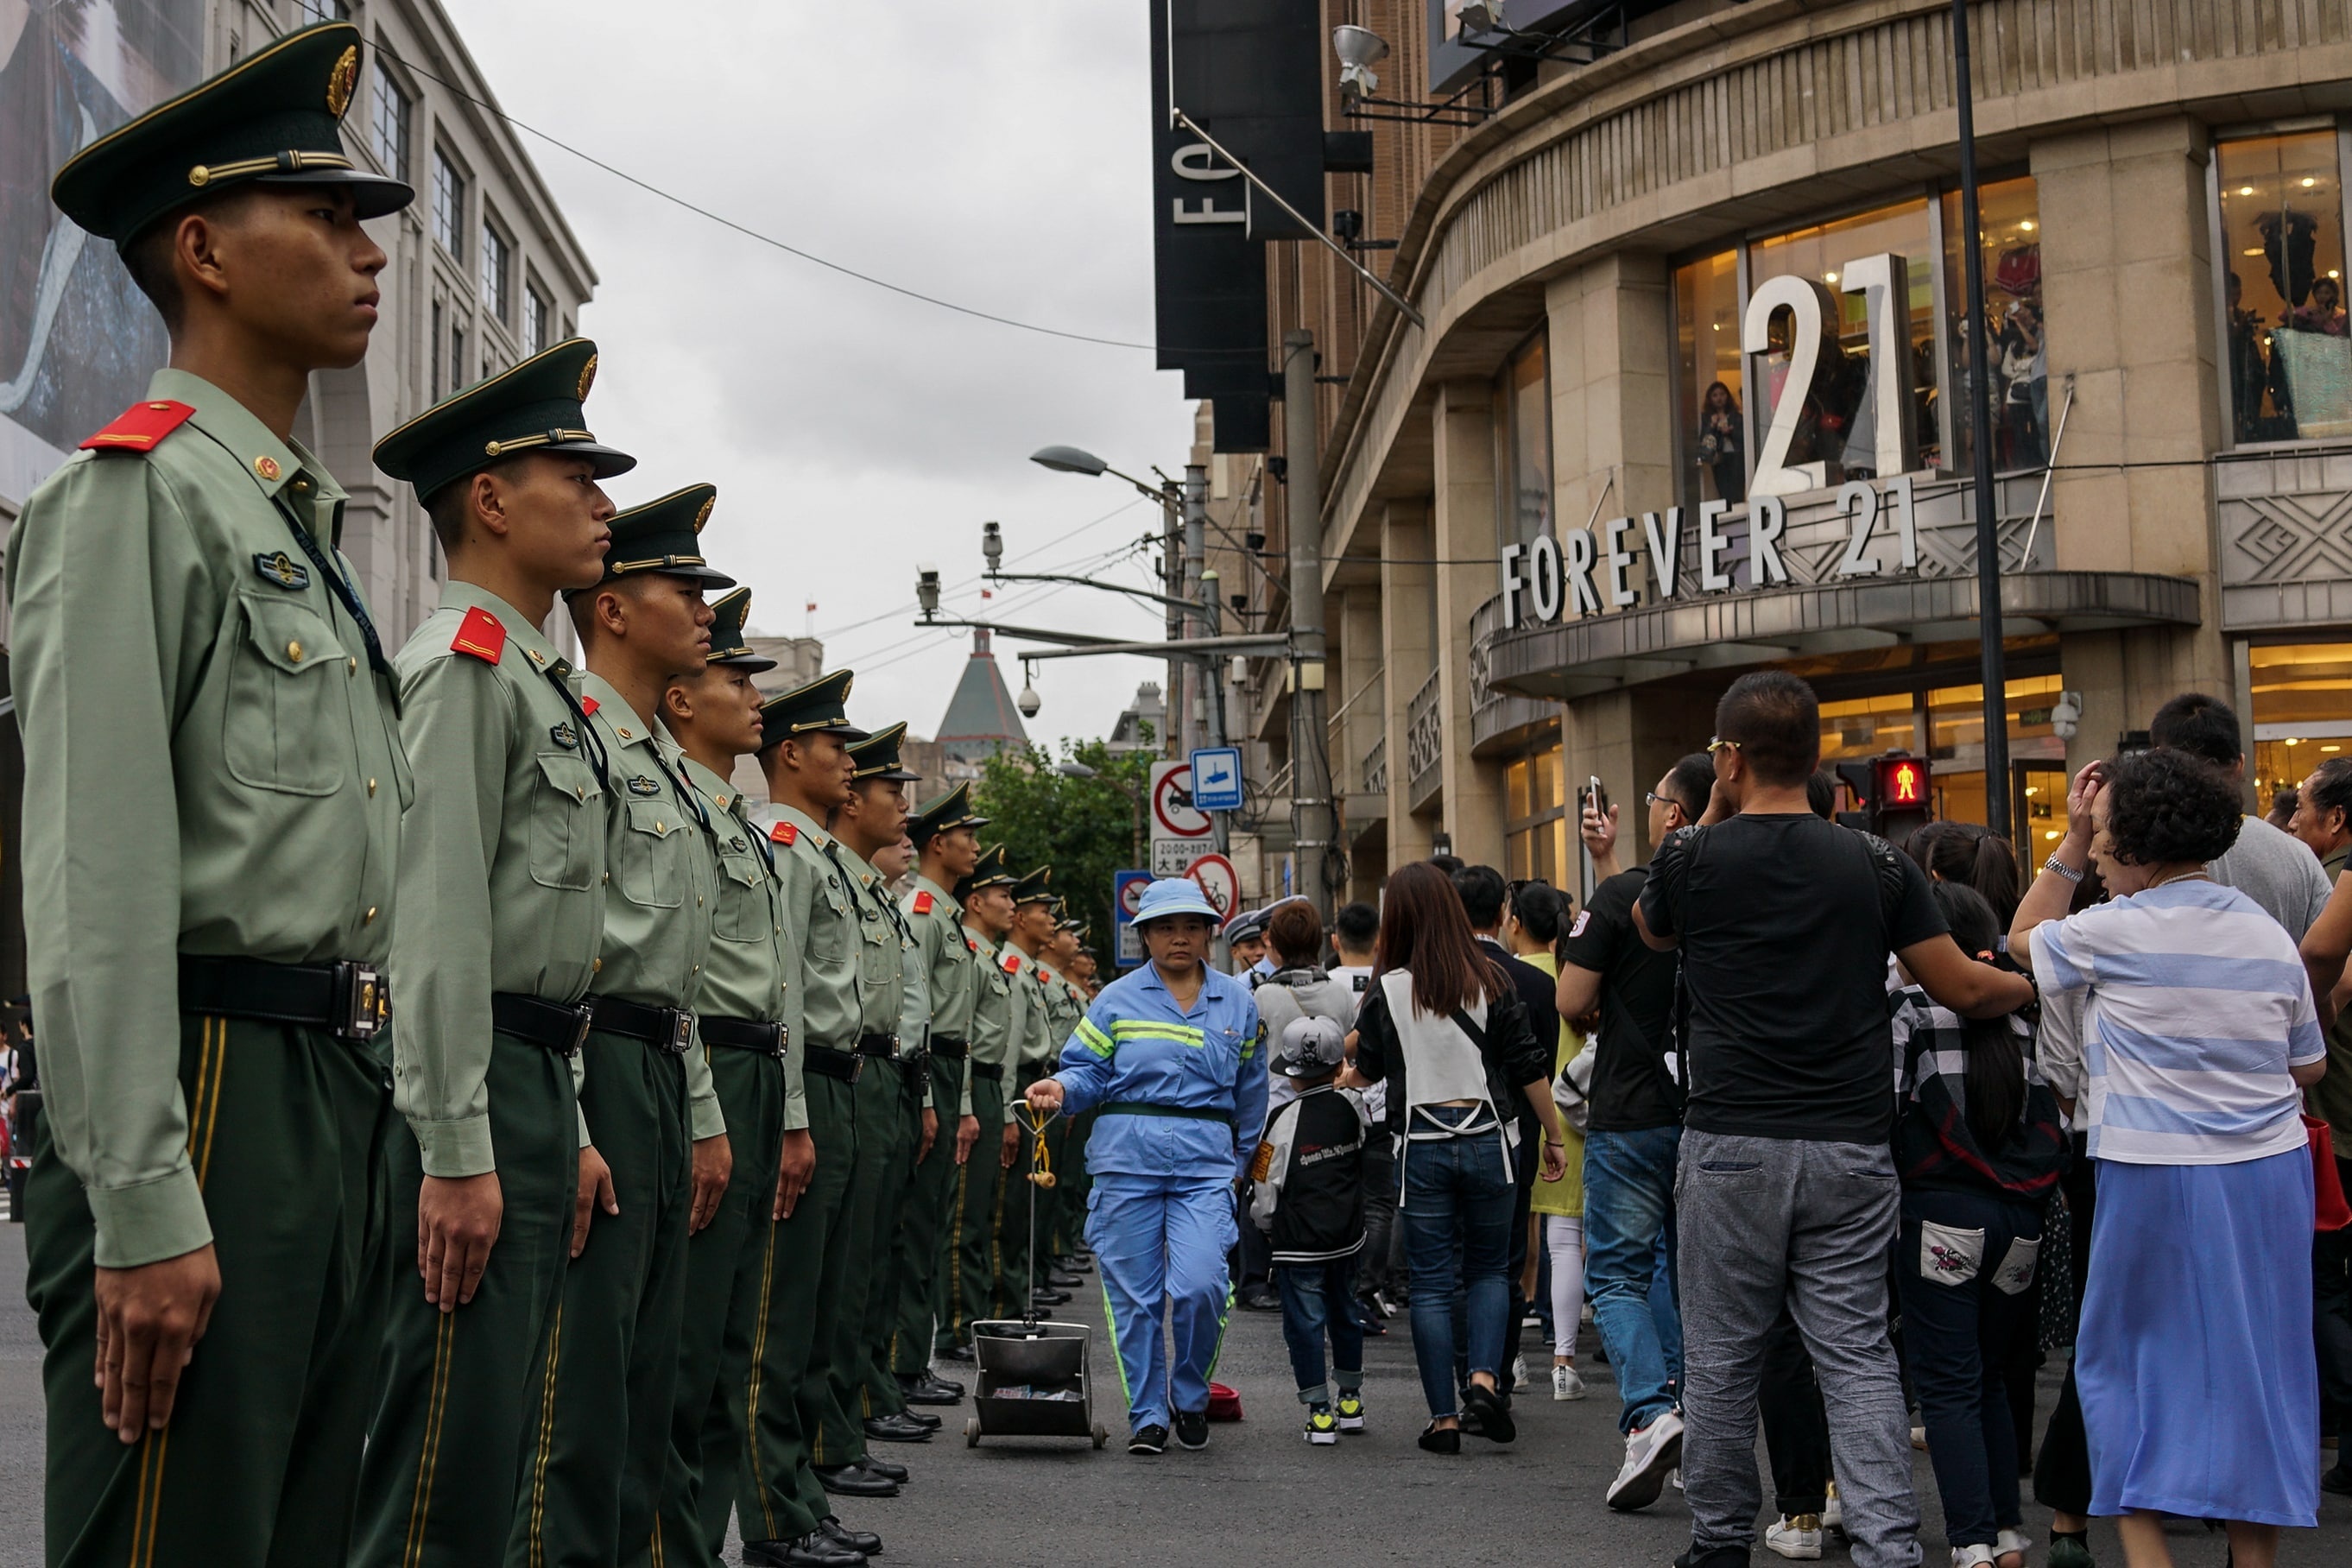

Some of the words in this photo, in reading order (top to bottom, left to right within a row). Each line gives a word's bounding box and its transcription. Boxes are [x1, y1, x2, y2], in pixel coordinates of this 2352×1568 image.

[1743, 253, 1910, 499] 21
[296, 531, 328, 572] POLICE
[1502, 496, 1788, 630] FOREVER
[1836, 476, 1918, 575] 21
